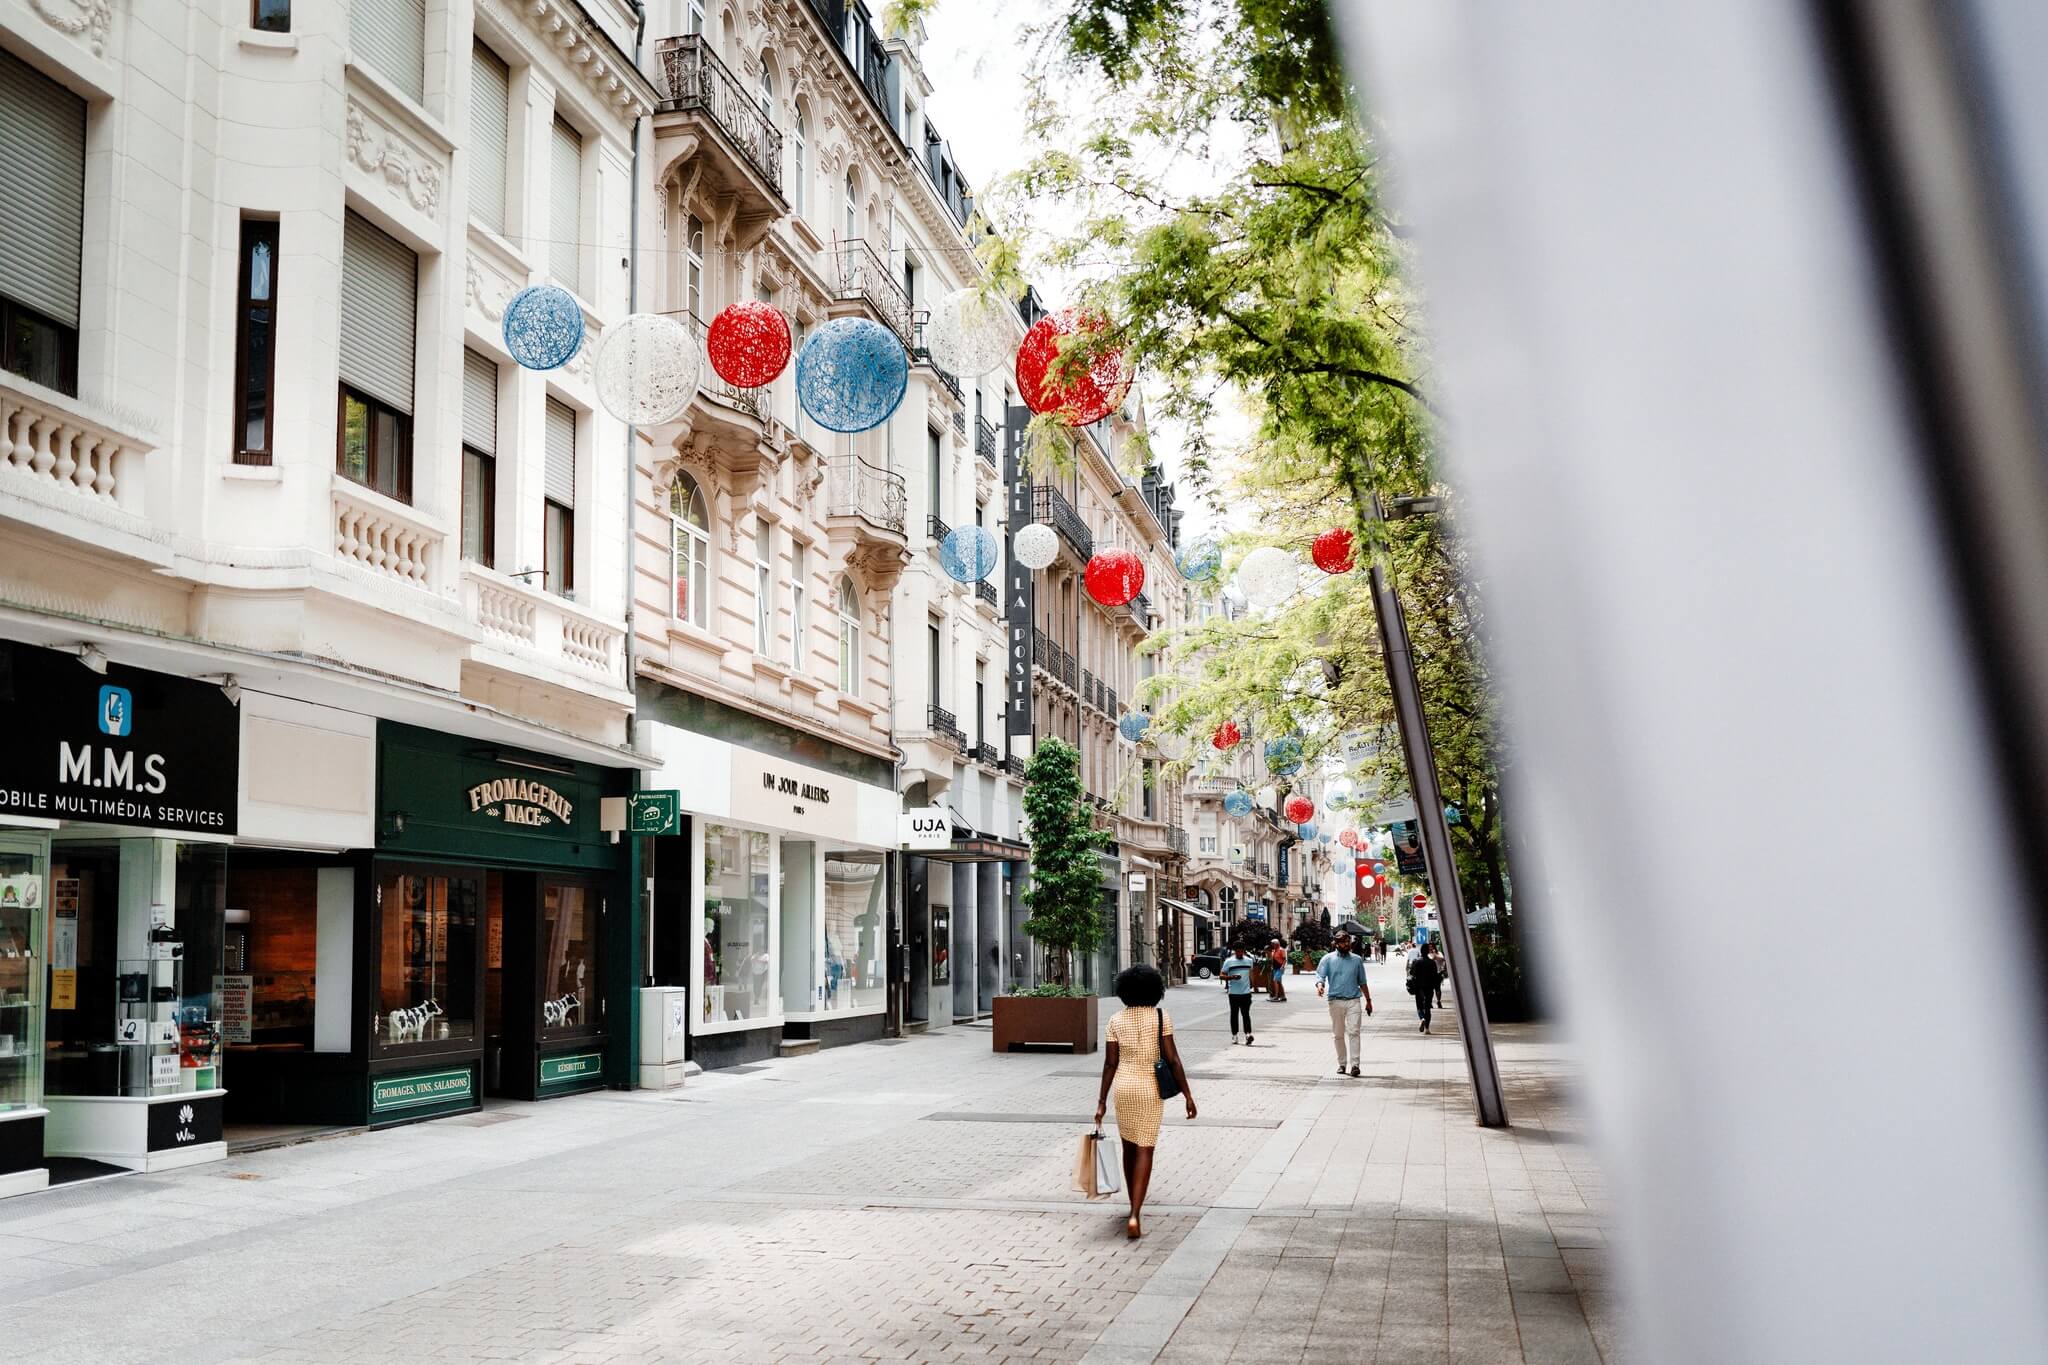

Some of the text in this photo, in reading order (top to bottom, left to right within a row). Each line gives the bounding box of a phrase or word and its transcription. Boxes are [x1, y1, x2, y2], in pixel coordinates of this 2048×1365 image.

[1014, 577, 1026, 608] LA
[1014, 628, 1026, 711] POSTE
[59, 741, 167, 794] M.M.S
[468, 778, 573, 825] FROMAGERIE
[763, 772, 830, 804] UN JOUR AILLEURS
[55, 795, 152, 819] MULTIMÉDIA
[158, 807, 224, 826] SERVICES
[503, 803, 541, 826] NACE
[913, 818, 946, 832] UJA
[377, 1078, 467, 1099] FROMAGES, VINS, SALAISONS
